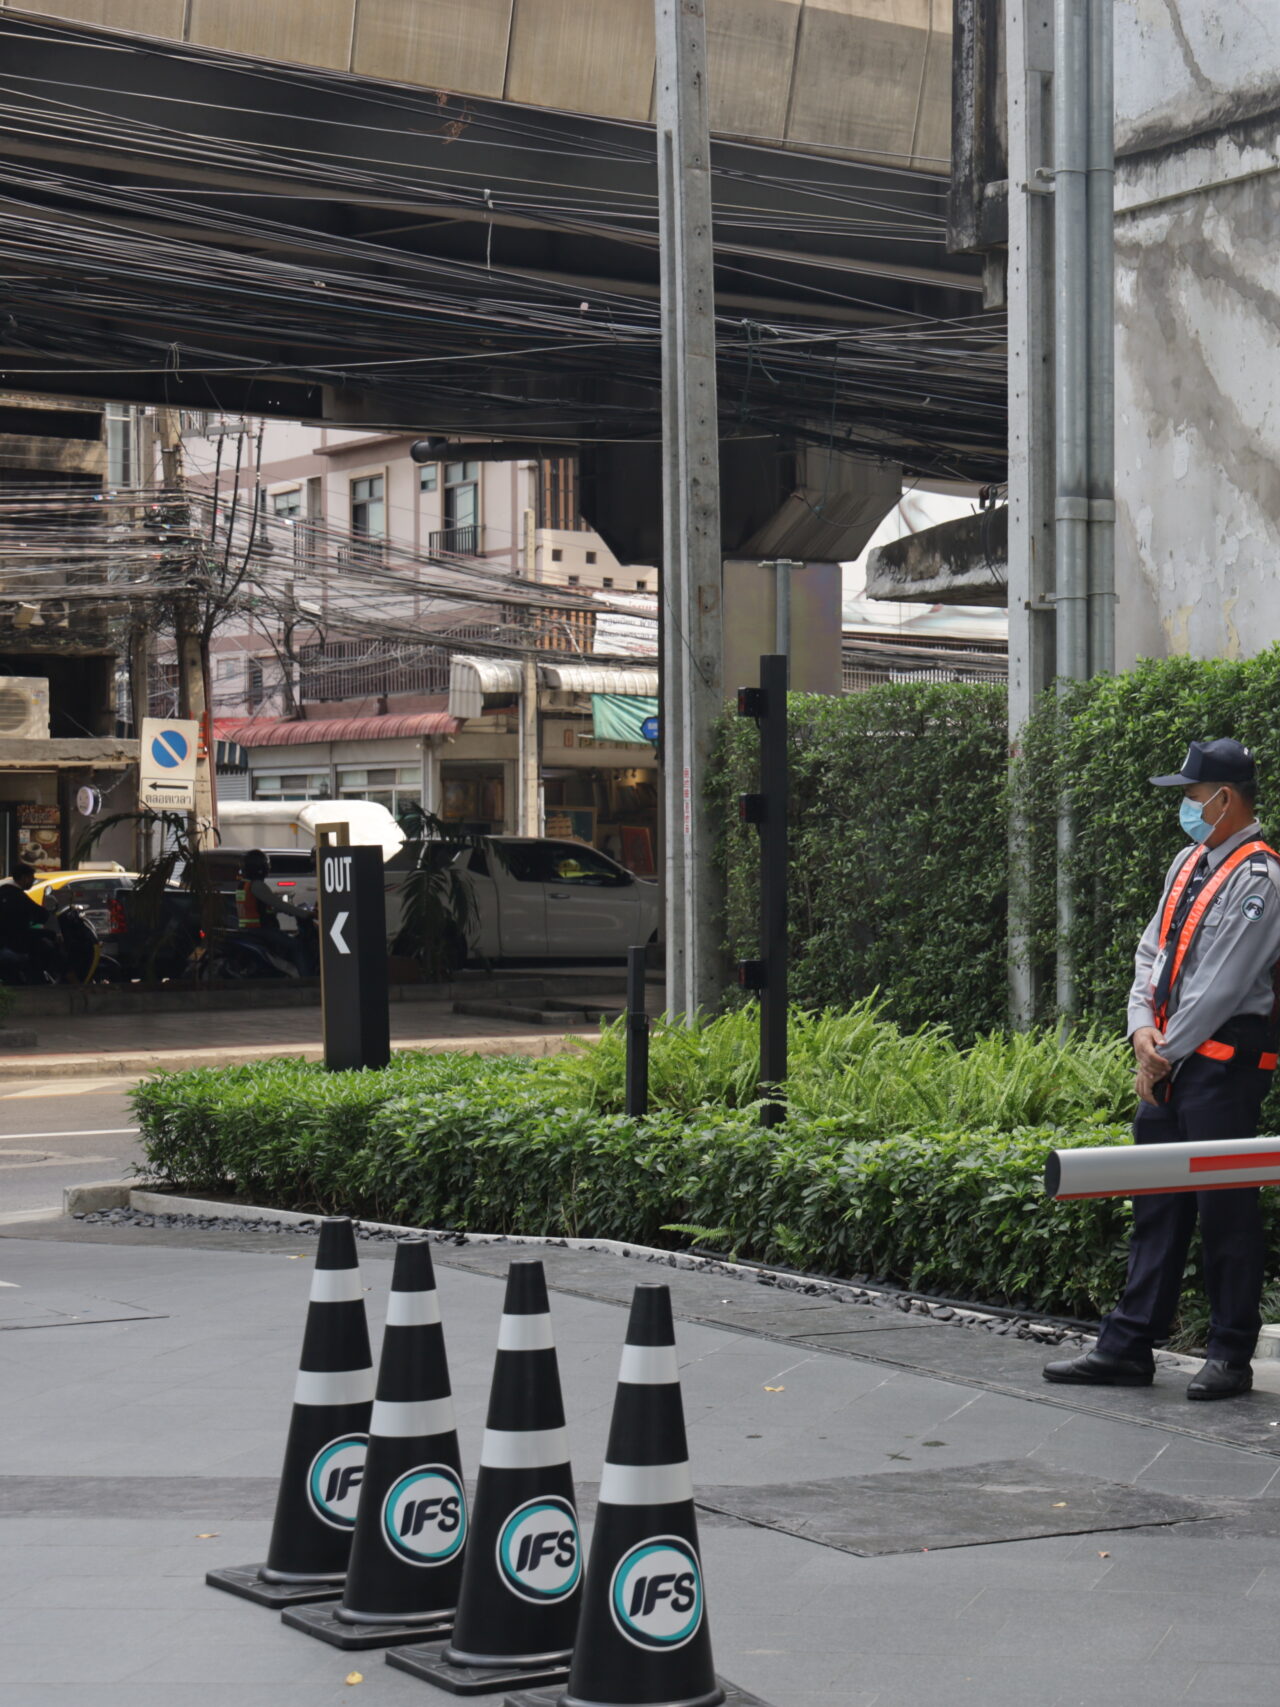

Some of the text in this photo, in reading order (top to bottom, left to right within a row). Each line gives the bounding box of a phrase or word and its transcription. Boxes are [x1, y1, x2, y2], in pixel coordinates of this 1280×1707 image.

[324, 856, 352, 893] OUT
[1246, 902, 1263, 916] IFS
[327, 1467, 363, 1501] IF
[400, 1497, 461, 1536] IFS
[516, 1531, 576, 1572] IFS
[630, 1572, 696, 1616] IFS
